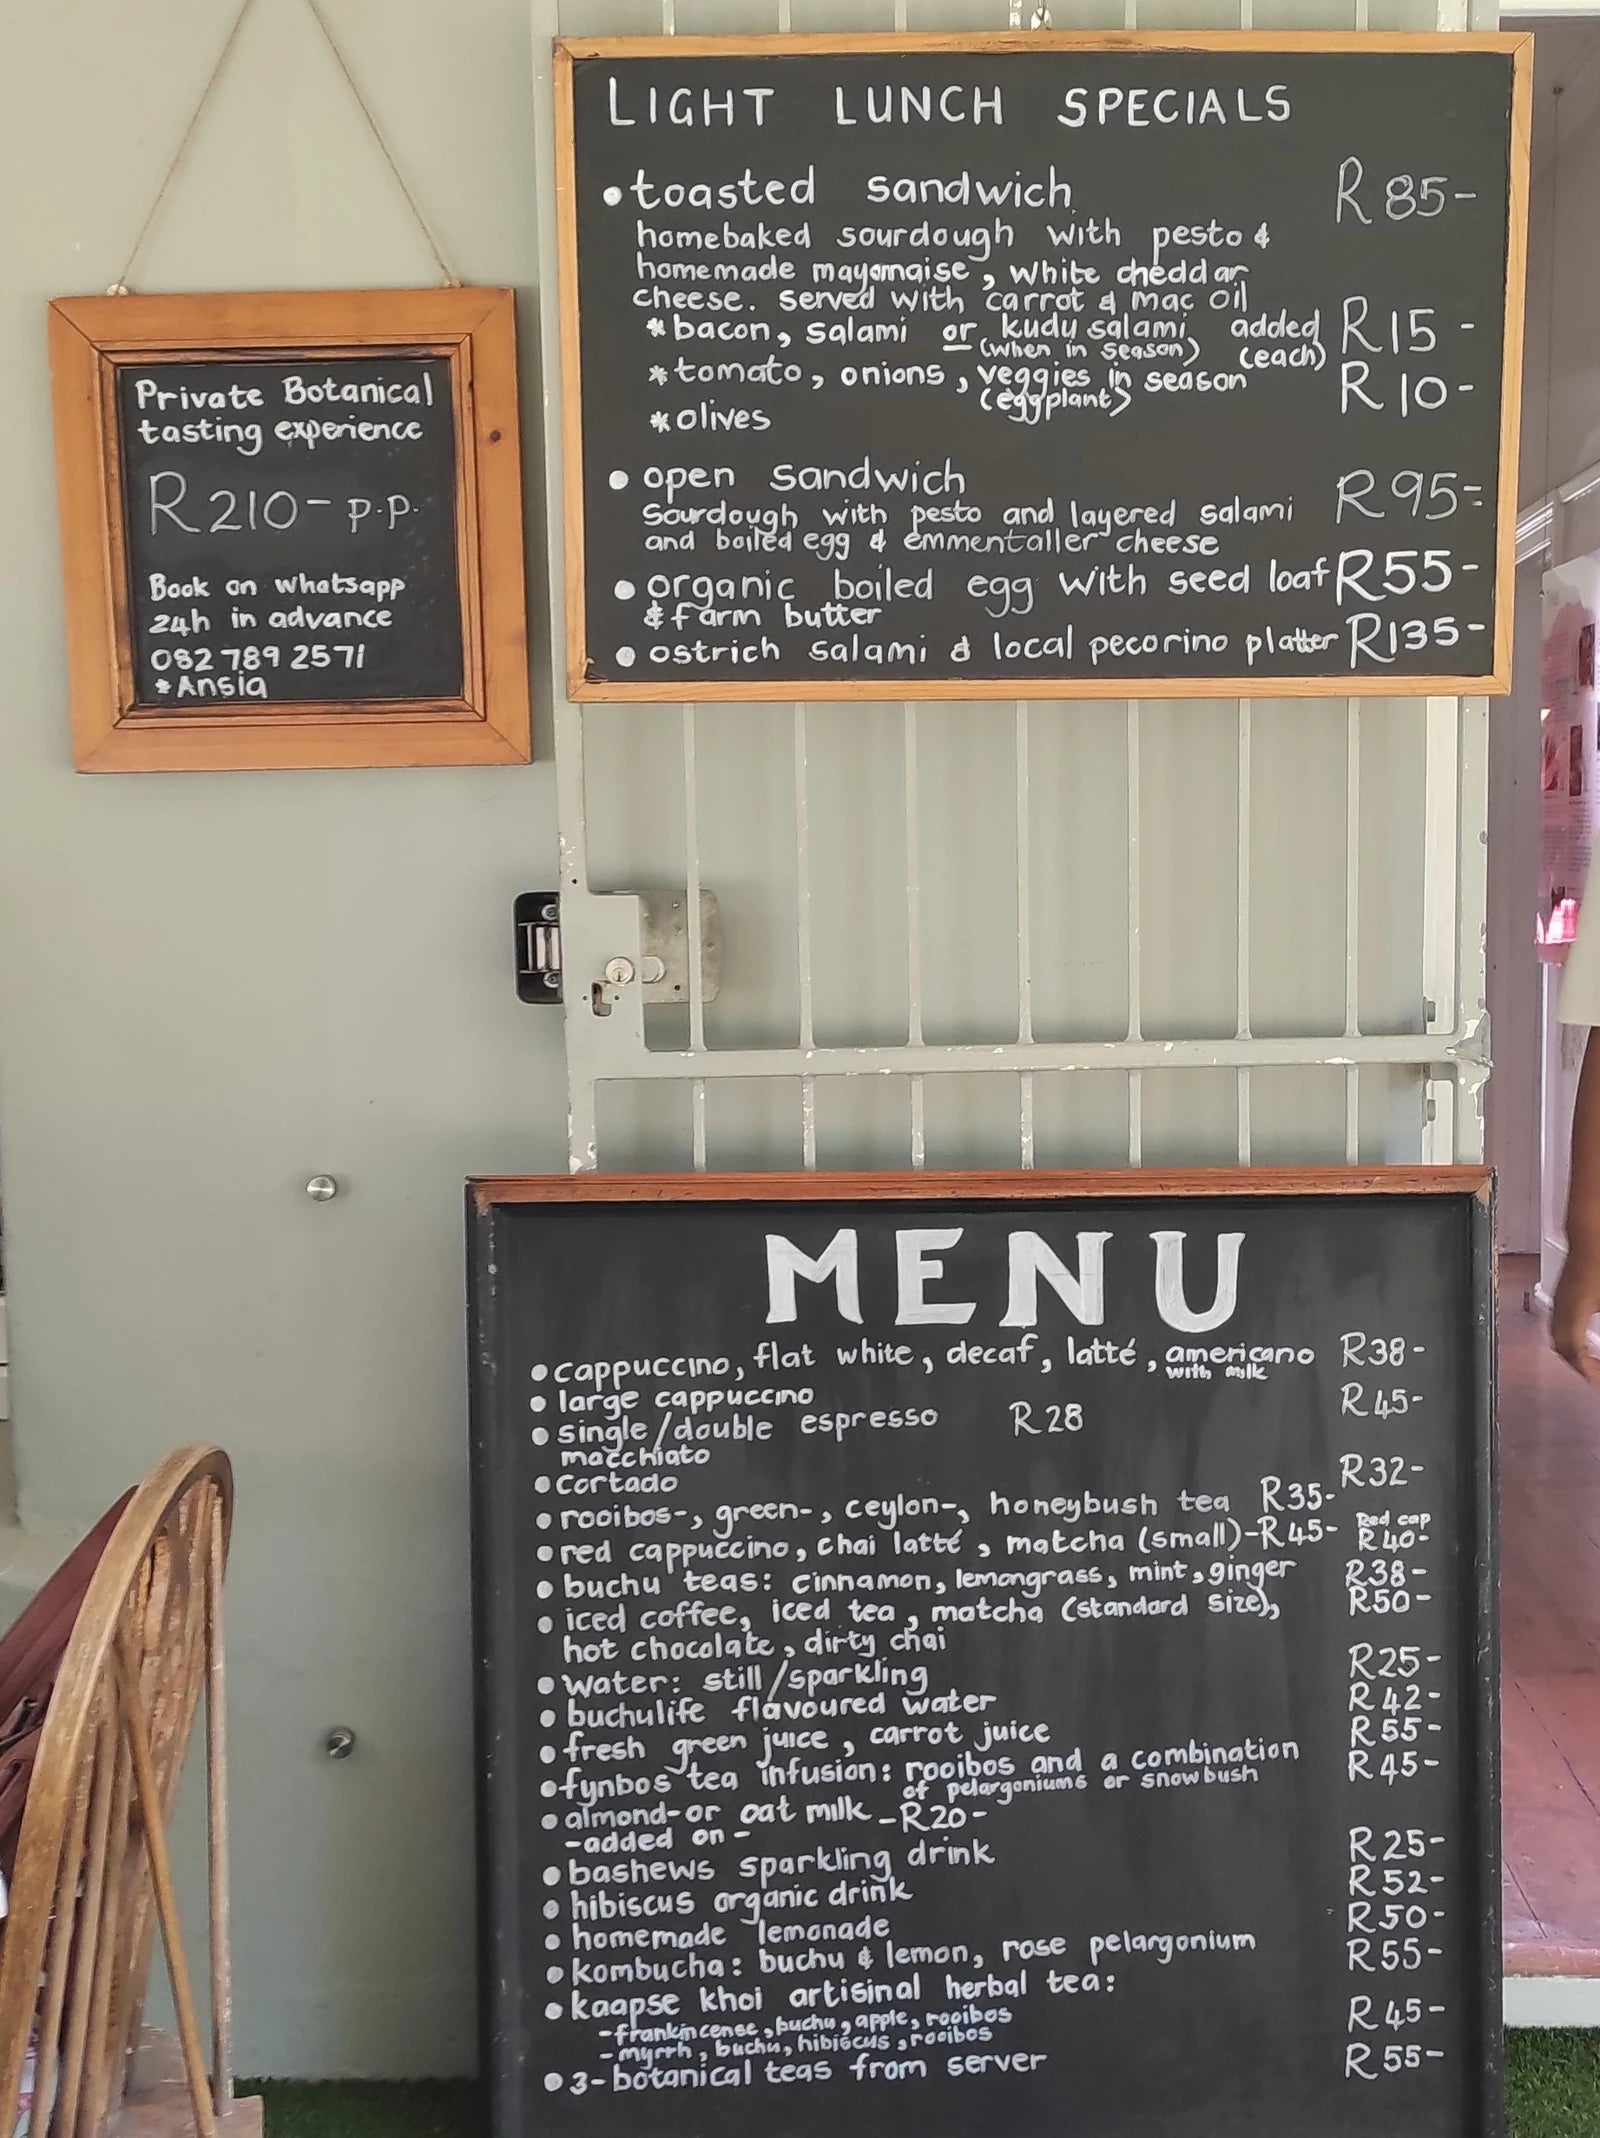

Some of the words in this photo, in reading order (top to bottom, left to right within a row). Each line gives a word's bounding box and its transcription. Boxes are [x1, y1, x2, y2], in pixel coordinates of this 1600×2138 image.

[609, 77, 775, 127] LIGHT
[836, 86, 1004, 125] LUNCH
[1057, 85, 1291, 127] SPECIALS
[629, 164, 816, 209] toasted
[867, 165, 1073, 208] sandwich
[637, 220, 811, 249] homebaked
[836, 218, 1015, 262] sourdough
[1046, 217, 1121, 247] with
[1153, 222, 1243, 265] pesto
[636, 252, 797, 280] homemade
[1010, 255, 1101, 285] white
[779, 287, 875, 311] served
[890, 287, 965, 313] with
[985, 290, 1085, 313] carrot
[1132, 291, 1194, 312] mac
[1209, 282, 1247, 312] oil
[805, 316, 907, 345] salami
[941, 323, 978, 351] or
[1087, 313, 1187, 341] salami
[1230, 308, 1321, 342] added
[980, 337, 1051, 358] (when
[1066, 340, 1087, 358] in
[1100, 338, 1201, 367] season)
[1239, 340, 1328, 371] (each)
[134, 378, 265, 411] Private
[281, 371, 434, 407] Botanical
[977, 361, 1091, 401] veggies
[1109, 361, 1132, 389] in
[1144, 370, 1247, 392] season
[676, 400, 772, 431] olives
[137, 417, 264, 457] tasting
[274, 414, 424, 451] experience
[643, 466, 736, 503] open
[769, 456, 967, 496] sandwich
[822, 499, 889, 526] with
[911, 500, 982, 539] pesto
[1003, 498, 1054, 525] and
[1071, 499, 1176, 537] layered
[1199, 496, 1294, 525] salami
[644, 532, 696, 552] and
[716, 526, 793, 553] boiled
[803, 532, 851, 561] egg
[1115, 531, 1221, 556] cheese
[149, 572, 211, 601] Book
[225, 578, 258, 596] on
[274, 572, 406, 602] whatsapp
[647, 570, 797, 611] organic
[834, 564, 933, 602] boiled
[967, 574, 1035, 619] egg
[1059, 564, 1147, 597] with
[1168, 564, 1250, 596] seed
[1269, 556, 1331, 594] loaf
[149, 608, 211, 637] 24h
[231, 606, 257, 629] in
[268, 605, 393, 631] advance
[785, 603, 882, 628] butter
[648, 635, 781, 666] ostrich
[808, 634, 927, 665] salami
[993, 624, 1072, 661] local
[1088, 628, 1229, 667] pecorino
[1246, 626, 1339, 667] platter
[764, 1226, 1246, 1334] MENU
[752, 1340, 817, 1370] flat
[1164, 1342, 1315, 1365] americano
[1165, 1364, 1212, 1380] with
[1225, 1363, 1269, 1380] milk
[559, 1388, 640, 1420] large
[654, 1387, 814, 1414] cappuccino
[799, 1406, 939, 1441] espresso
[560, 1444, 711, 1469] macchiato
[555, 1473, 679, 1495] cortado
[989, 1488, 1159, 1523] honeybush
[1180, 1489, 1230, 1513] tea
[559, 1539, 612, 1566] red
[817, 1532, 876, 1557] chai
[1006, 1529, 1125, 1555] matcha
[563, 1572, 661, 1599] buchu
[1208, 1555, 1297, 1590] ginger
[565, 1603, 627, 1633] iced
[772, 1597, 831, 1624] iced
[931, 1596, 1044, 1623] matcha
[1061, 1593, 1189, 1622] (standard
[562, 1634, 620, 1663] hot
[803, 1627, 876, 1657] dirty
[889, 1625, 947, 1651] chai
[567, 1698, 706, 1728] buchulife
[730, 1692, 886, 1722] flavoured
[901, 1690, 998, 1716] water
[562, 1730, 646, 1762] fresh
[664, 1731, 748, 1773] green
[869, 1721, 964, 1746] carrot
[974, 1720, 1051, 1751] juice
[559, 1759, 672, 1806] fynbos
[686, 1761, 739, 1792] tea
[905, 1750, 1016, 1782] rooibos
[1031, 1747, 1082, 1774] and
[1101, 1753, 1118, 1772] a
[1130, 1737, 1300, 1771] combination
[902, 1779, 929, 1800] of
[946, 1774, 1088, 1805] pelargoniums
[1103, 1773, 1130, 1789] or
[740, 1800, 797, 1825] oat
[806, 1795, 872, 1822] milk
[569, 1856, 716, 1886] bashews
[738, 1845, 892, 1889] sparkling
[906, 1838, 995, 1868] drink
[570, 1889, 696, 1922] hibiscus
[713, 1881, 818, 1925] organic
[827, 1876, 914, 1907] drink
[572, 1922, 727, 1952] homemade
[758, 1915, 891, 1944] lemonade
[758, 1947, 845, 1974] buchu
[1002, 1935, 1067, 1961] rose
[1089, 1929, 1256, 1965] pelargonium
[570, 1989, 681, 2028] kaapse
[700, 1985, 763, 2013] khoi
[788, 1971, 921, 2009] artisinal
[945, 1970, 1028, 1999] herbal
[925, 2003, 1013, 2027] rooibos
[910, 2026, 993, 2047] rooibos
[612, 2058, 752, 2093] botanical
[764, 2057, 833, 2084] teas
[849, 2053, 927, 2081] from
[945, 2050, 1048, 2079] server
